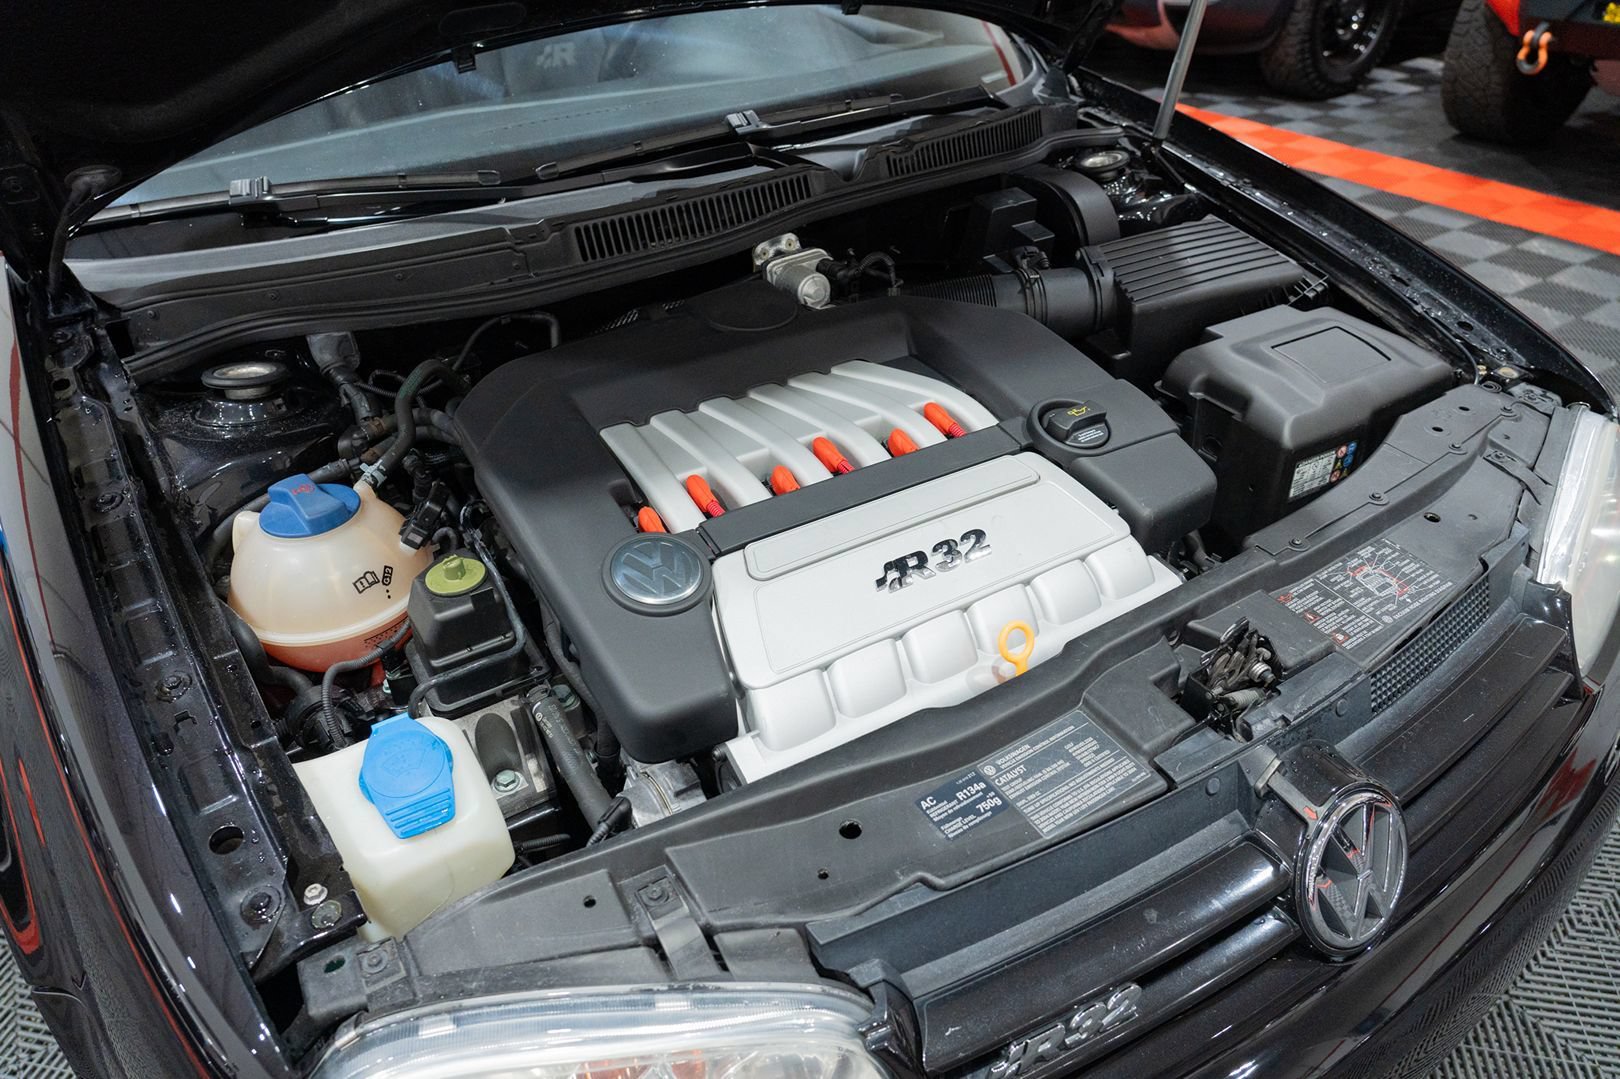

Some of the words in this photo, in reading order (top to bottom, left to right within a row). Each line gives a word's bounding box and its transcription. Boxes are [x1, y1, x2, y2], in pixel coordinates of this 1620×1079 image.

[875, 528, 992, 593] R32
[995, 765, 1027, 786] CATALYST
[956, 782, 986, 800] R134a
[920, 796, 936, 810] AC
[976, 796, 1002, 813] 750g
